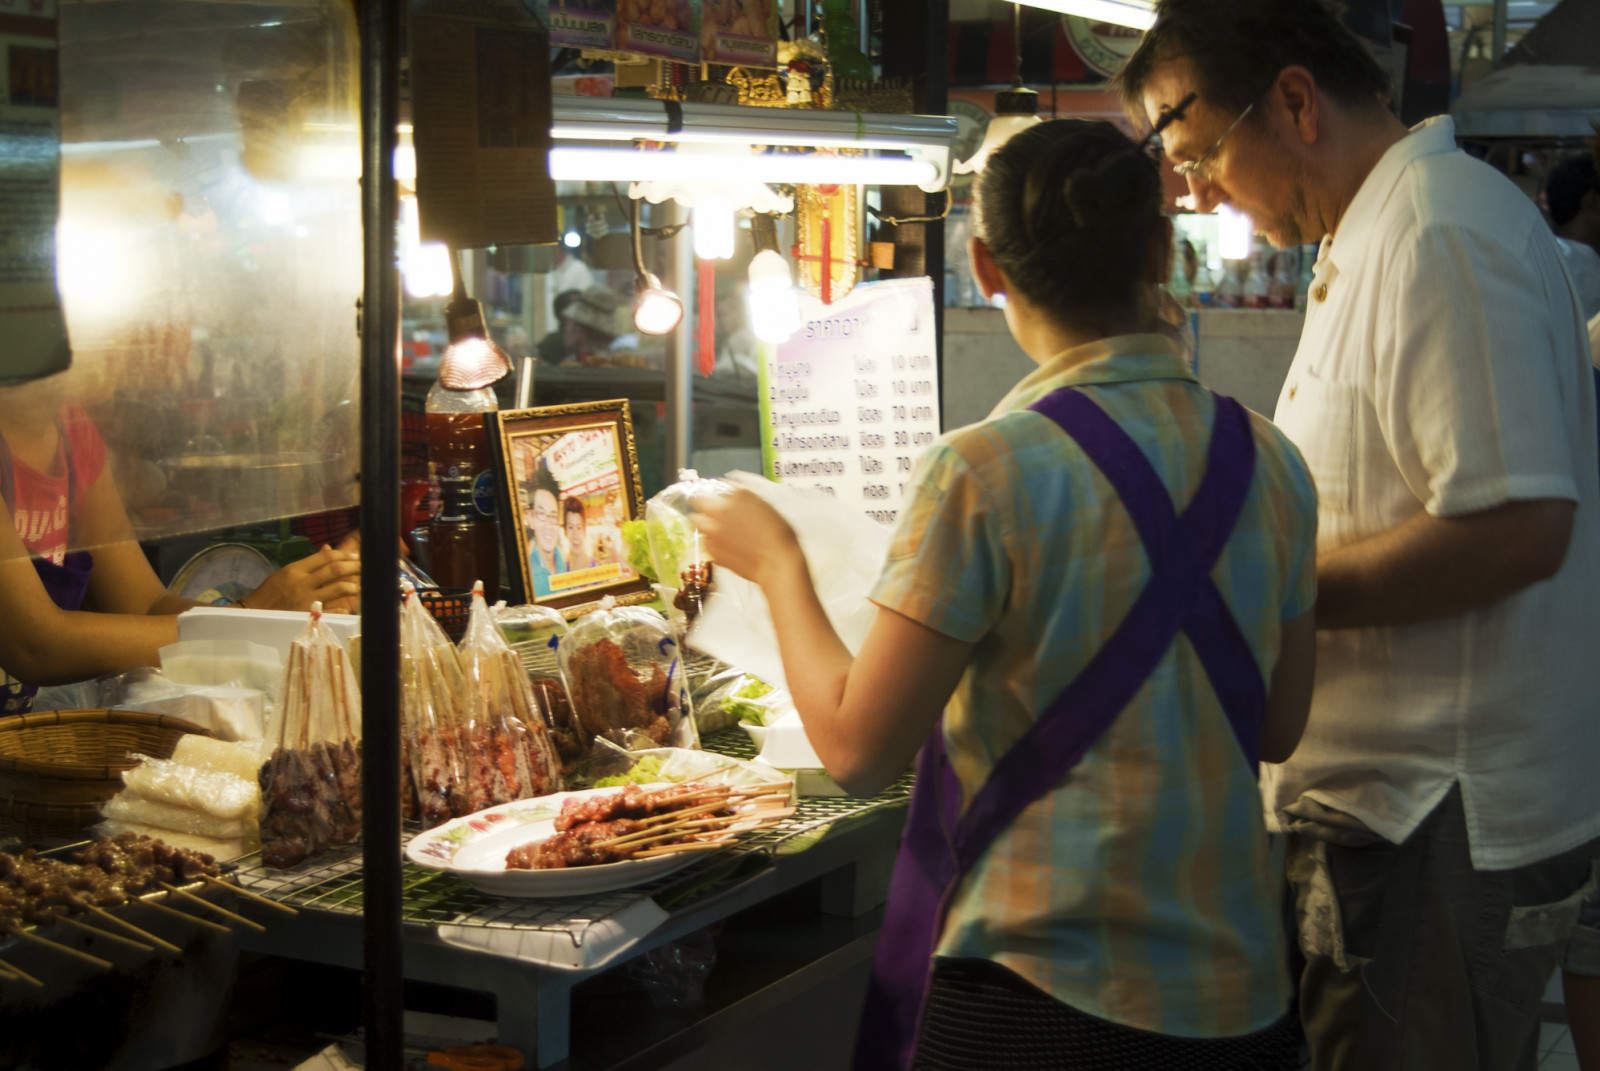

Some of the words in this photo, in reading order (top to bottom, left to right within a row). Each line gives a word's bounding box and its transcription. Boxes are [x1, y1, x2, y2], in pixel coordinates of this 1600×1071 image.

[893, 380, 906, 395] 10
[892, 406, 906, 420] 70
[894, 431, 908, 446] 30
